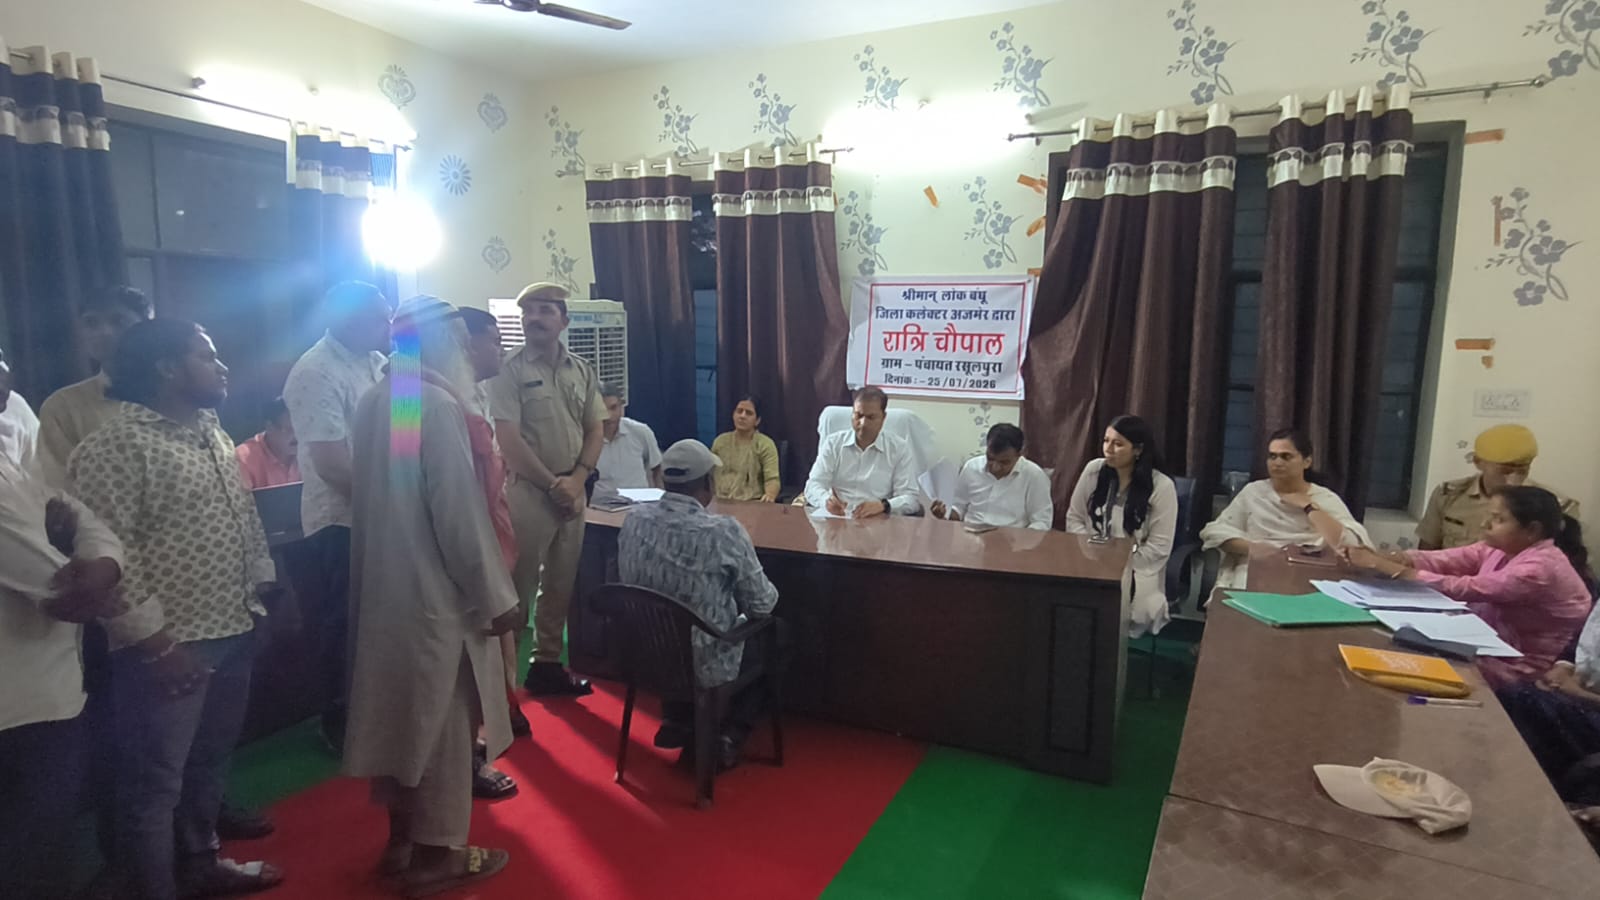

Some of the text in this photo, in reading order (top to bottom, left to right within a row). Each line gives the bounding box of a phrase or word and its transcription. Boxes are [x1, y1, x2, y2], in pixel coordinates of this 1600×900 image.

[901, 288, 937, 303] श्रीमान्
[940, 288, 966, 301] लोक
[875, 305, 903, 320] जिला
[905, 306, 948, 321] कलेक्टर
[950, 307, 988, 321] अजमेर
[882, 322, 1005, 355] रात्रि चौपाल
[881, 357, 902, 369] ग्राम
[914, 355, 953, 371] पंचायत
[954, 360, 1002, 377] रसूलपुरा
